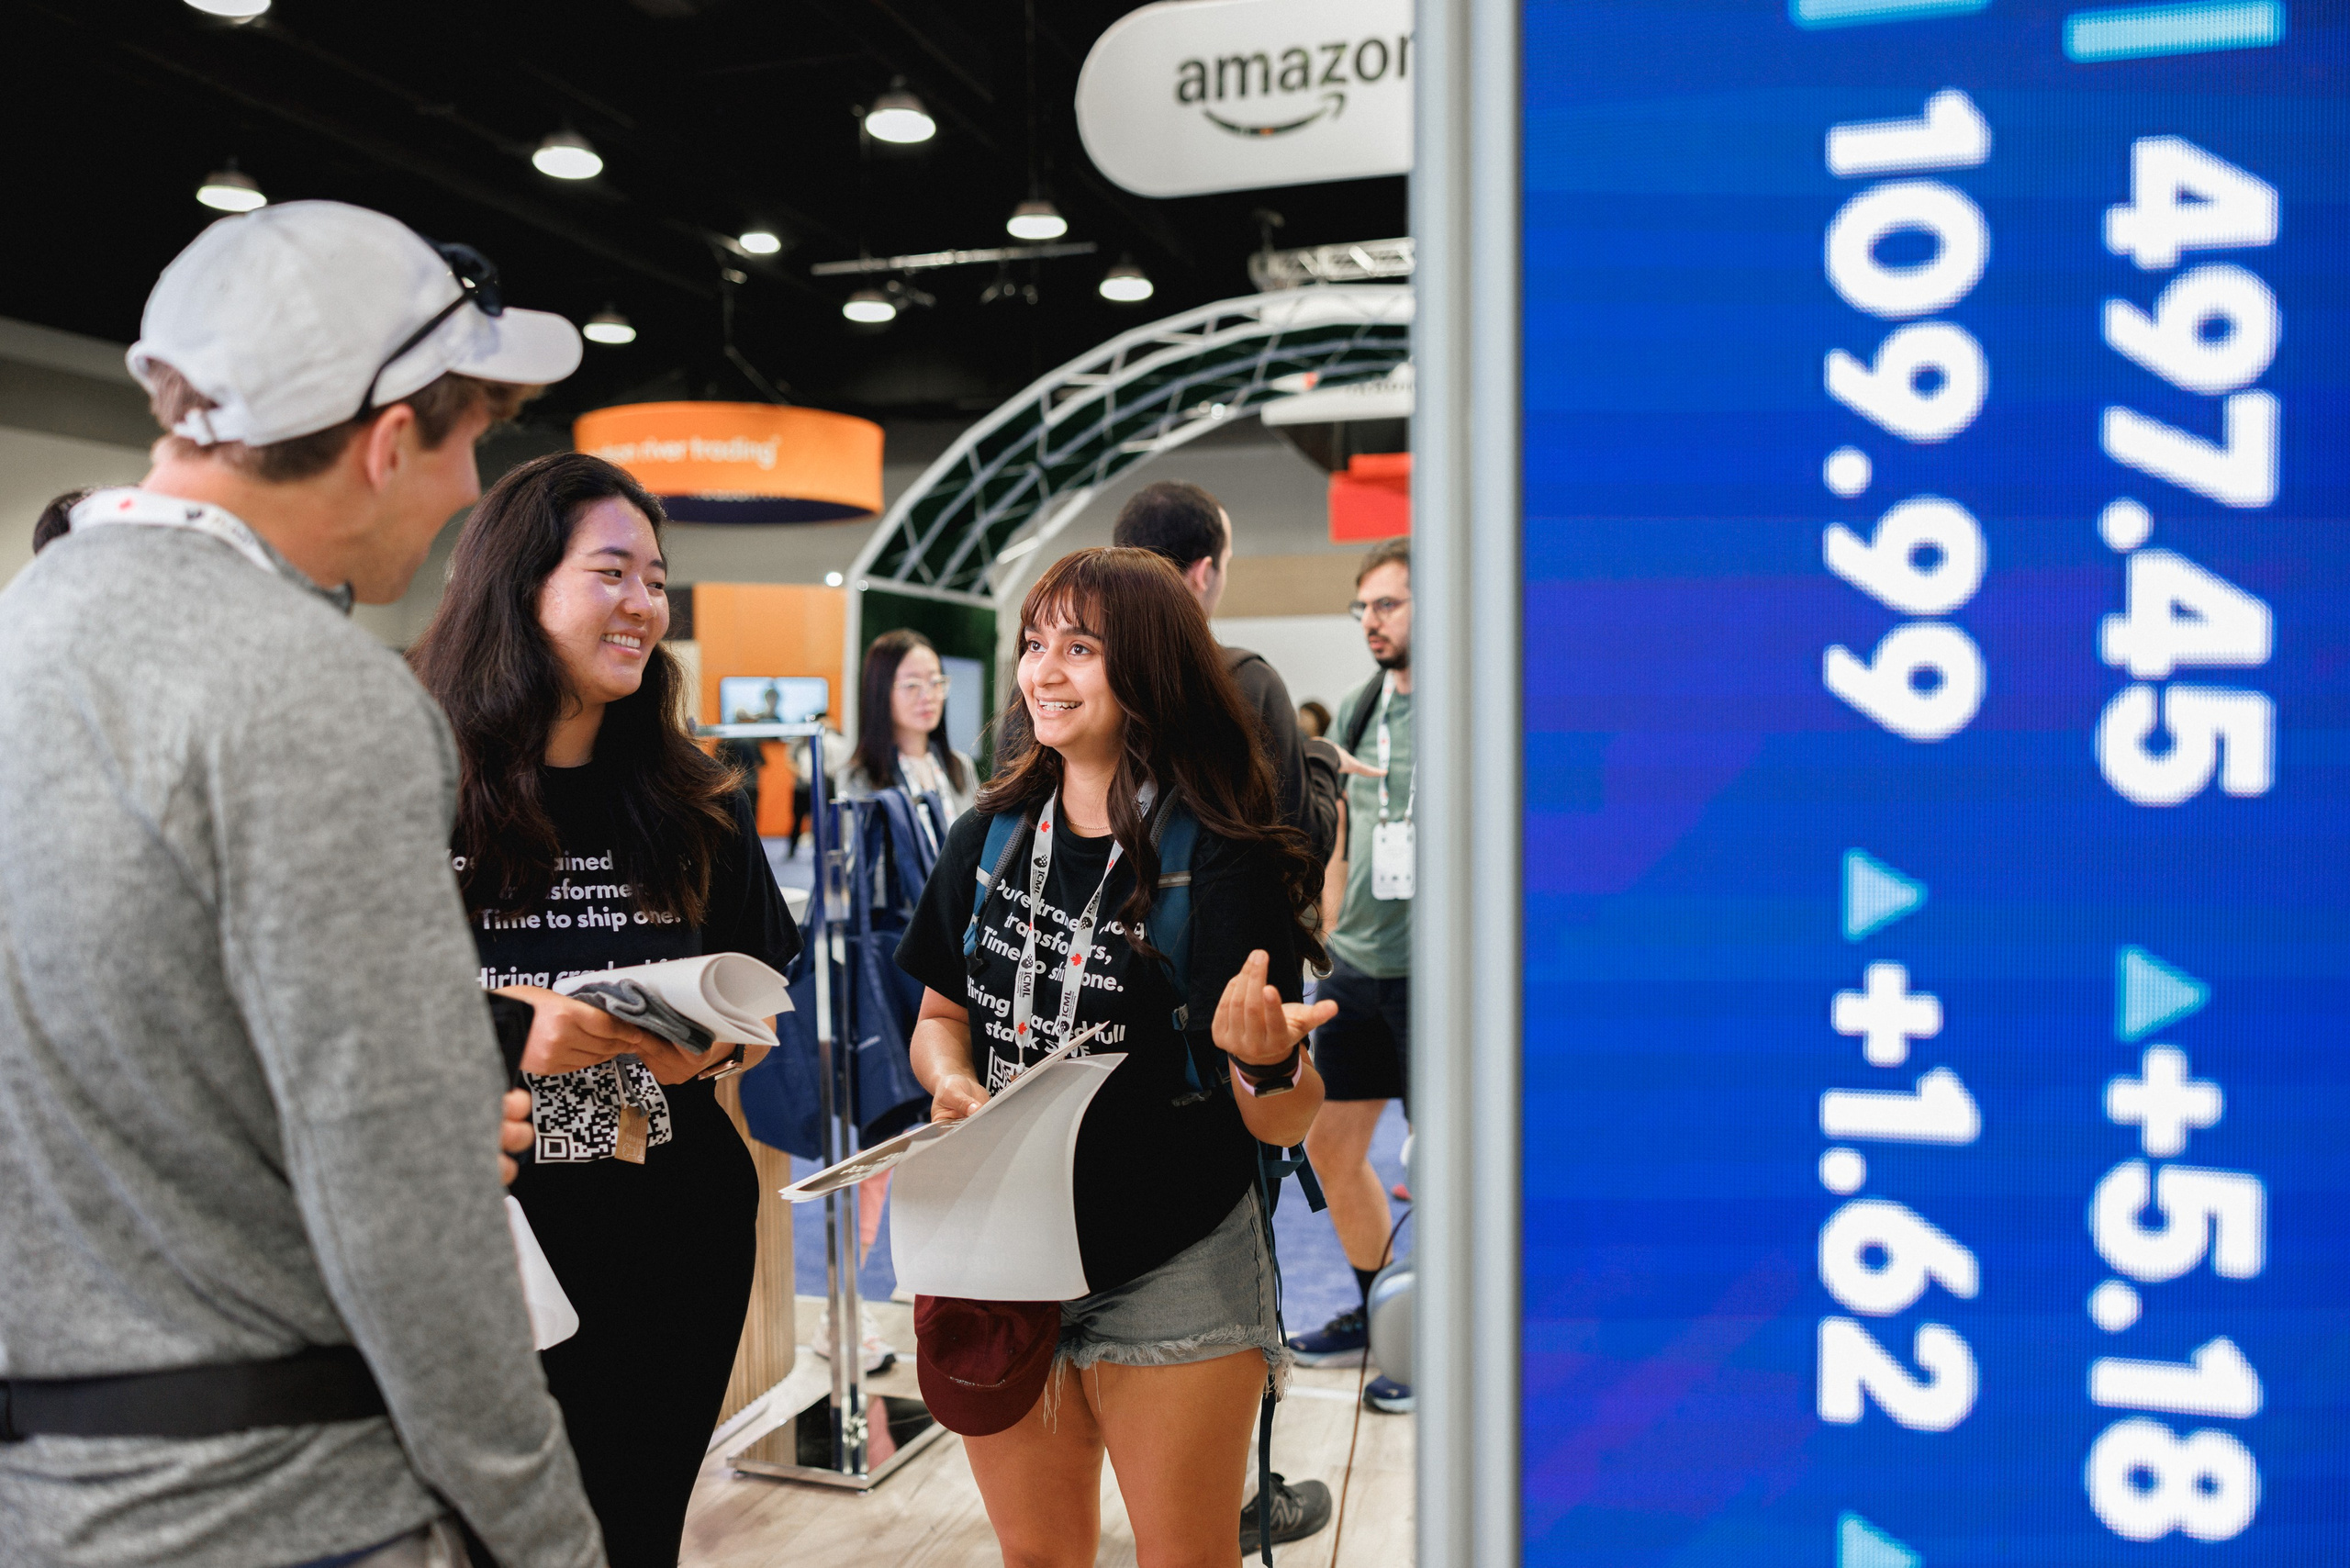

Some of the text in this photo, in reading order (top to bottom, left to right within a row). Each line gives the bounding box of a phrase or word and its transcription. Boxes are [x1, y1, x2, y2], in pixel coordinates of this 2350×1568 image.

[1817, 87, 1991, 1432] 109.99 +1.62
[2087, 135, 2280, 1542] 497.45 +5.18
[552, 848, 614, 871] ained
[482, 906, 682, 932] Time to ship one.
[1004, 913, 1113, 964] transfors,
[981, 926, 1022, 961] Time
[1048, 961, 1067, 982] shi
[1081, 972, 1125, 992] one.
[1022, 971, 1033, 998] ICML
[1061, 990, 1072, 1017] ICML
[985, 1020, 1040, 1051] stak
[1030, 1013, 1088, 1038] ackd
